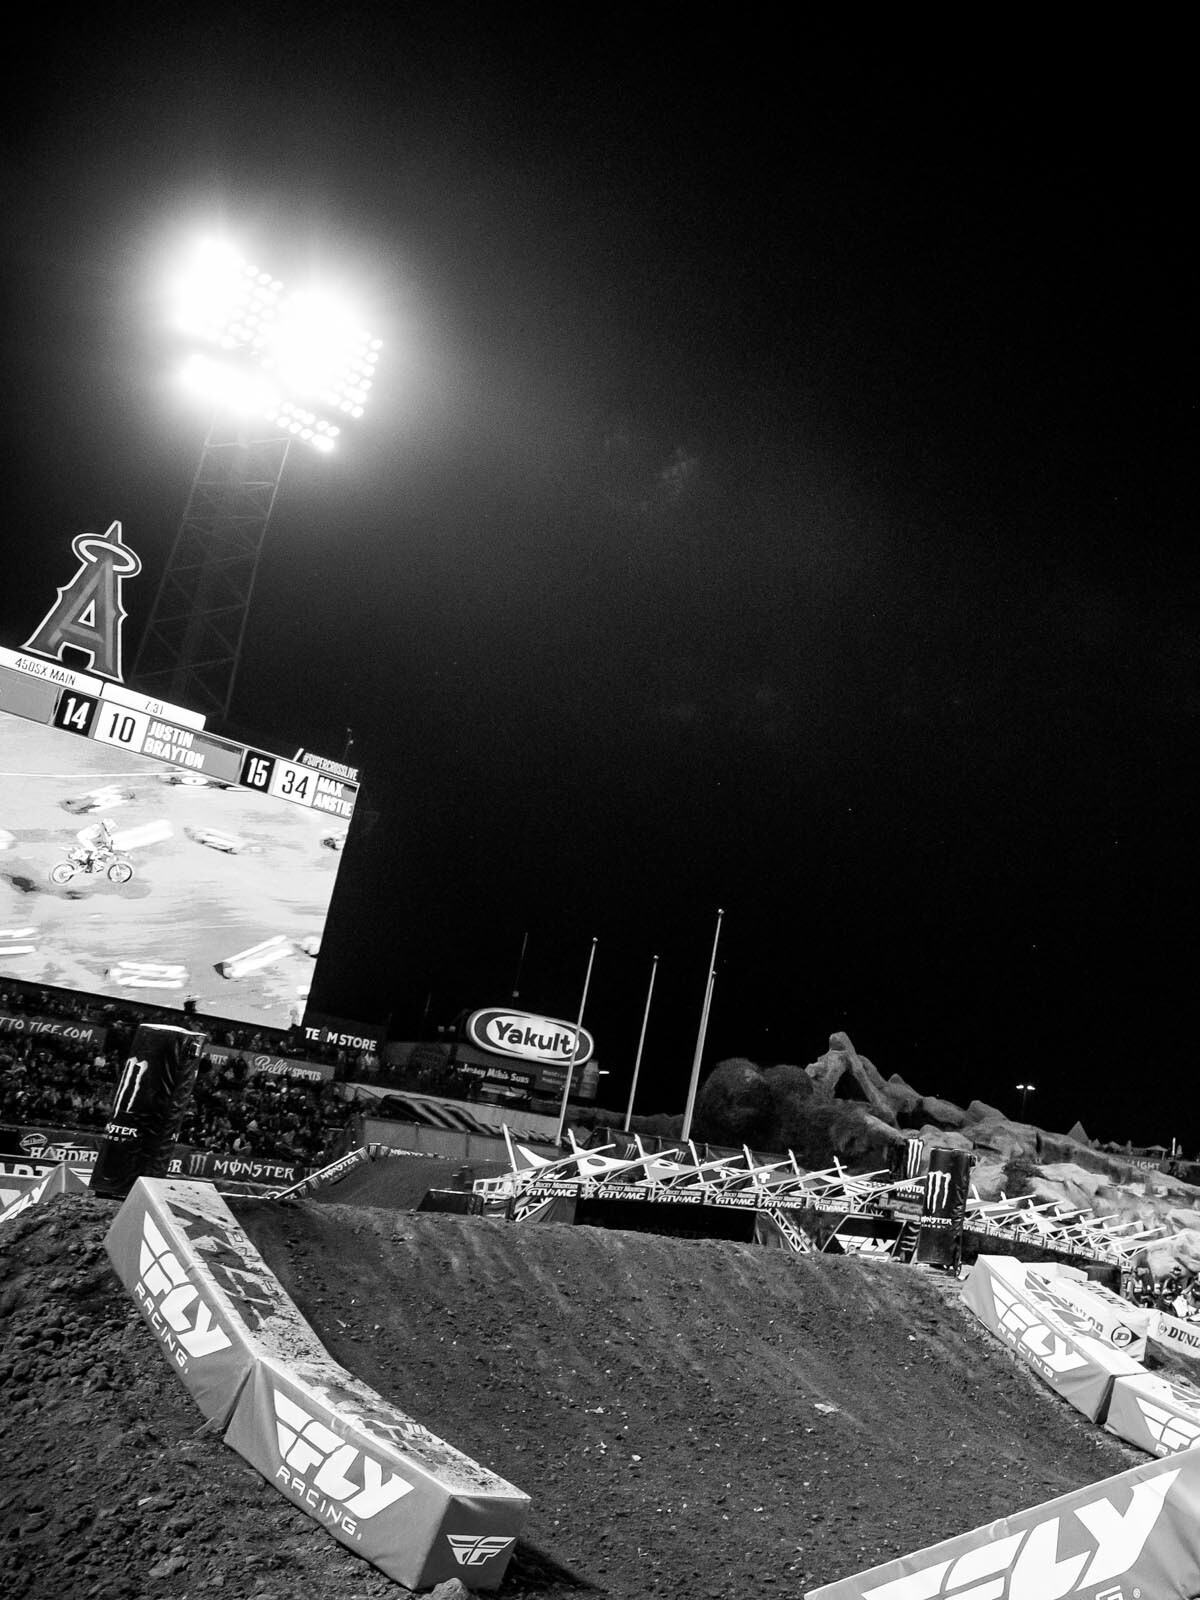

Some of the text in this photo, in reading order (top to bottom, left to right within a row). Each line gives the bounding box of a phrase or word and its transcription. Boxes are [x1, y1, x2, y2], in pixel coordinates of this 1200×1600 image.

[49, 668, 77, 686] MAIN
[62, 697, 91, 730] 14
[108, 712, 136, 743] 10
[147, 721, 195, 748] JUSTIN
[143, 737, 206, 769] BRAYTON
[247, 757, 270, 787] 15
[282, 770, 309, 799] 34
[317, 776, 345, 798] MAX
[313, 793, 354, 817] ANSTIE
[29, 1021, 94, 1043] TIRE.COM
[305, 1027, 377, 1051] TEM STORE
[494, 1020, 574, 1055] Yakult
[139, 1210, 232, 1358] FLY
[134, 1281, 187, 1368] RACING
[273, 1389, 416, 1519] FLY
[276, 1465, 357, 1537] RACING
